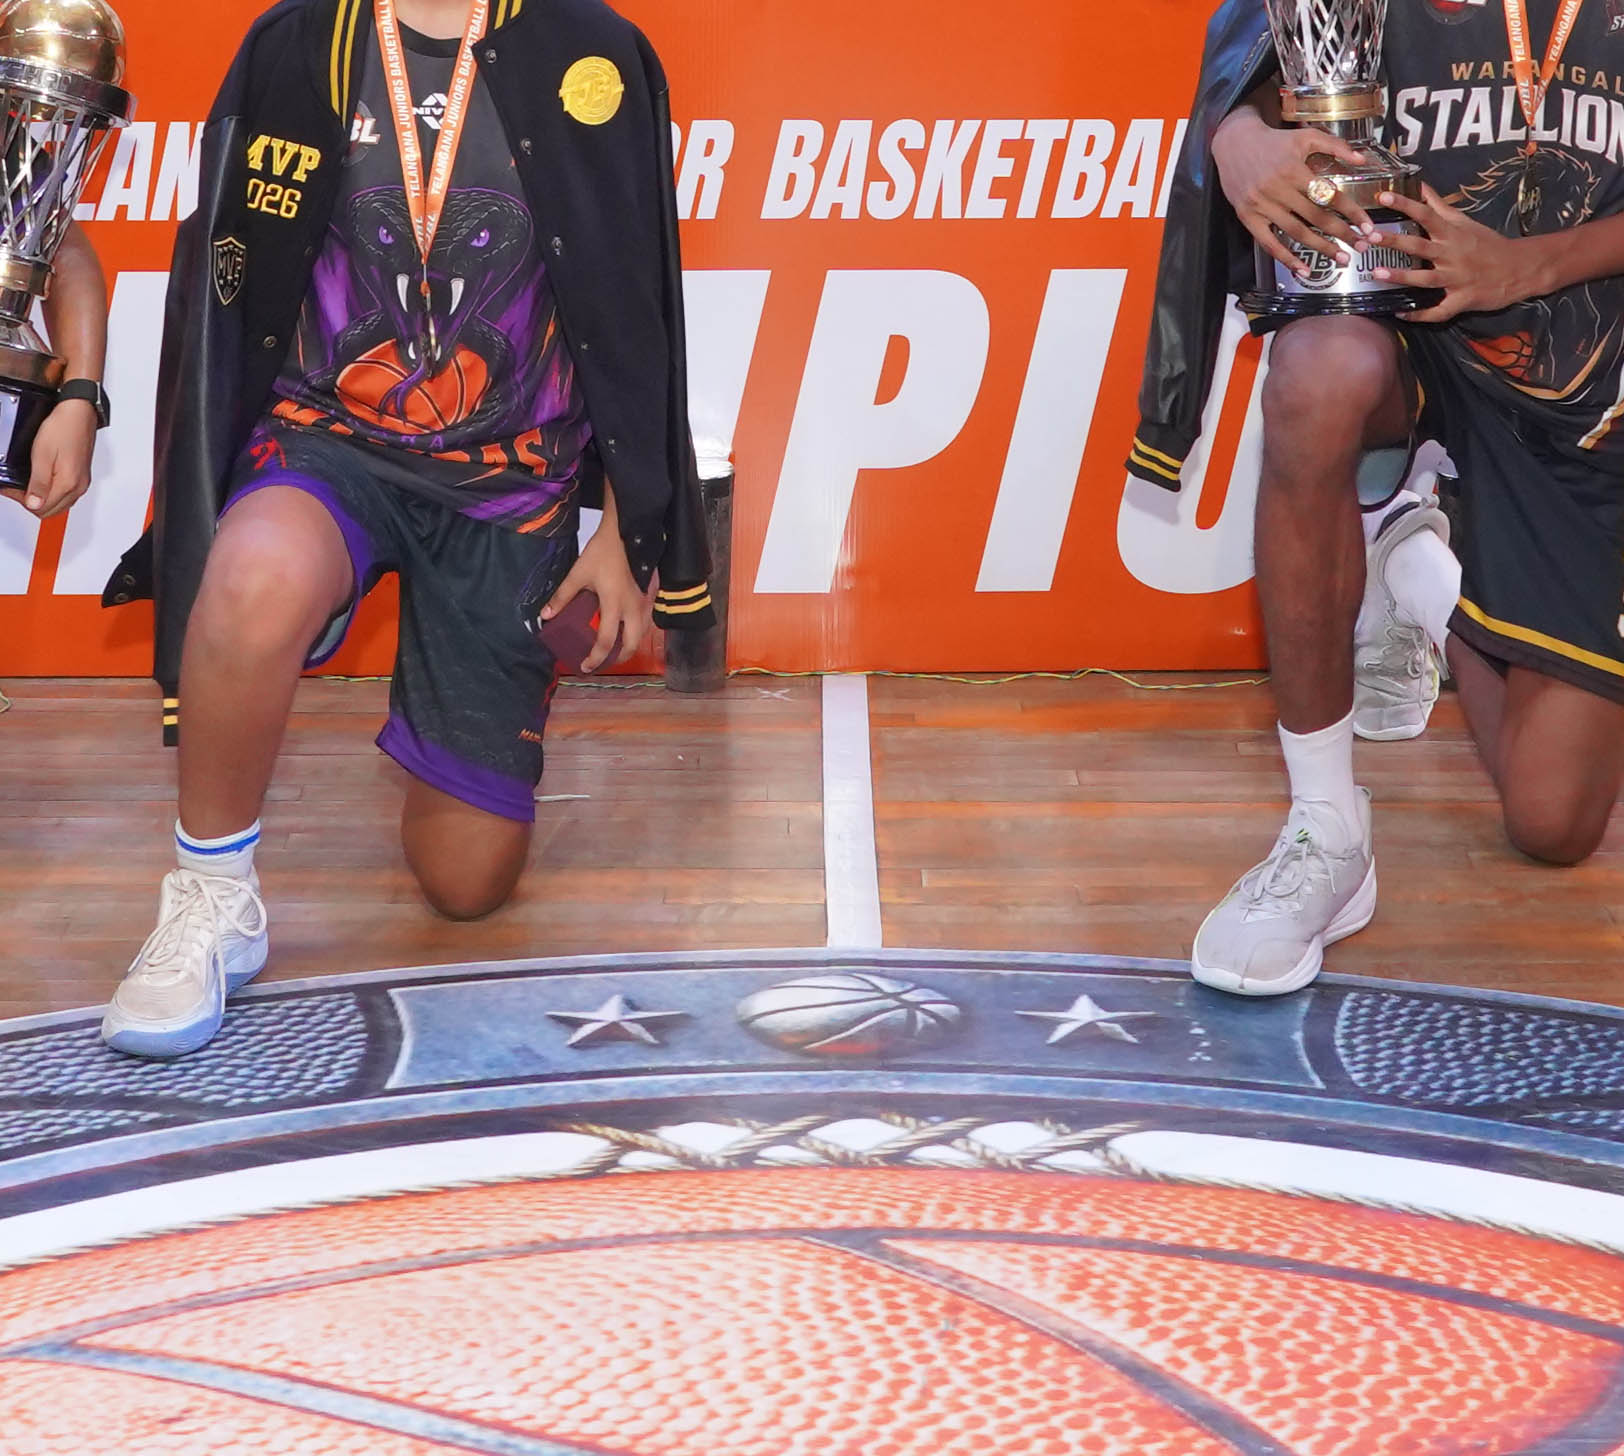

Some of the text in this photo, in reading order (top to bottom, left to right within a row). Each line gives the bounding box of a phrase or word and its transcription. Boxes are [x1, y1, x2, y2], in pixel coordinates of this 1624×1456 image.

[383, 10, 404, 78] BASKETBALL
[1508, 0, 1526, 62] TELANGANA
[393, 80, 413, 129] JUNIORS
[432, 129, 455, 194] TELANGANA
[446, 78, 468, 128] JUNIORS
[403, 132, 421, 198] TELANGANA
[761, 118, 1190, 219] BASKETBA
[247, 178, 302, 219] 026
